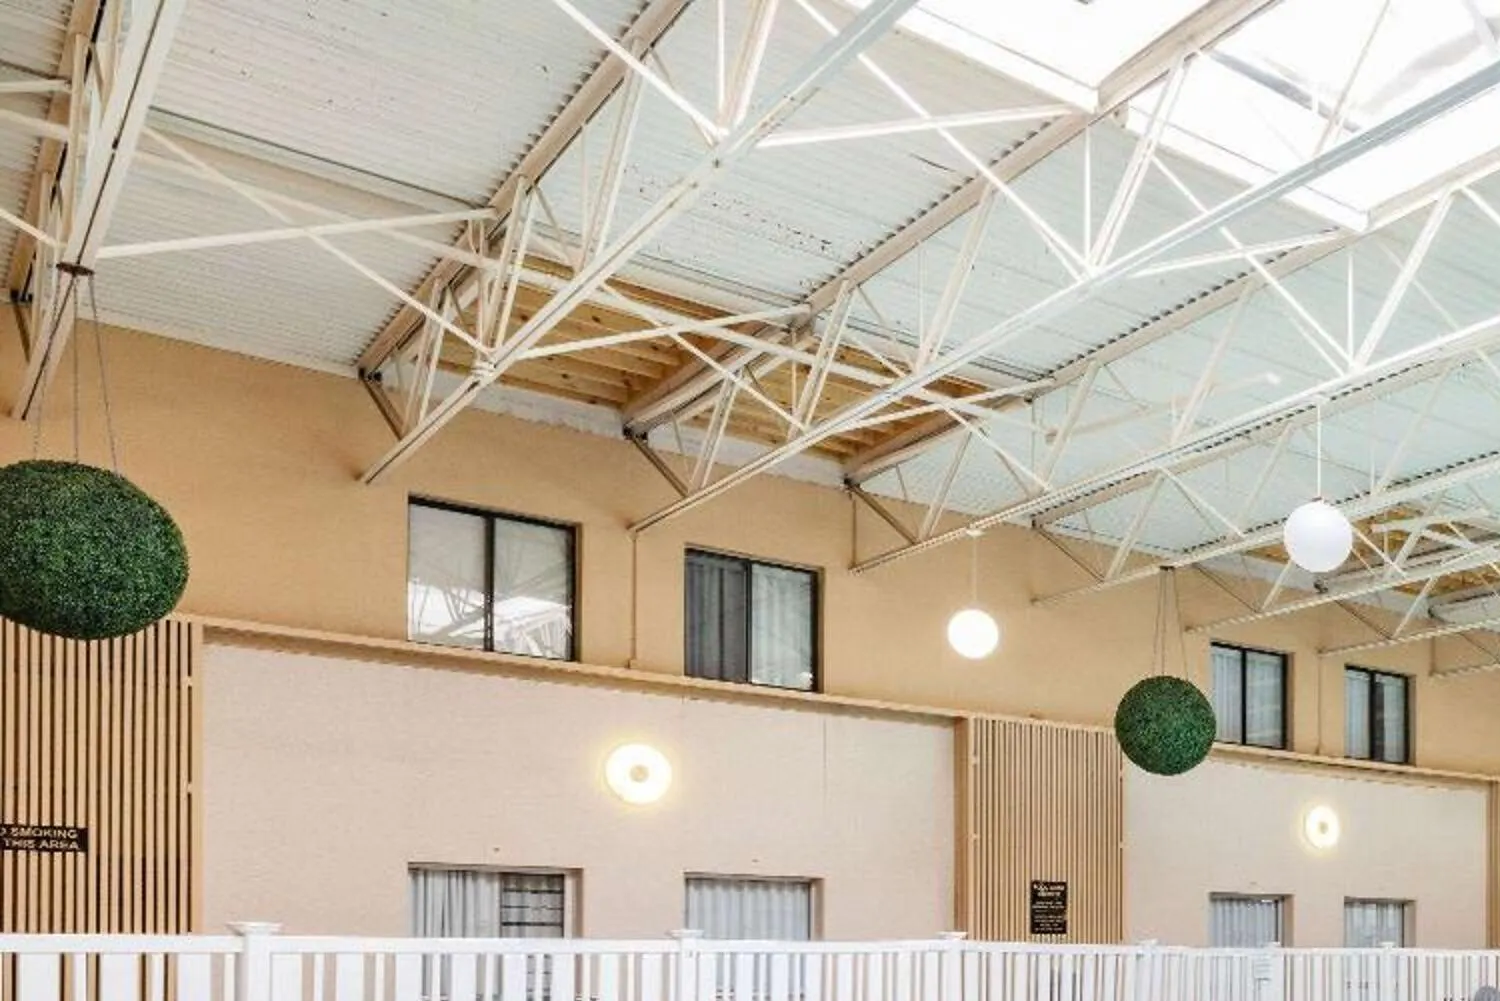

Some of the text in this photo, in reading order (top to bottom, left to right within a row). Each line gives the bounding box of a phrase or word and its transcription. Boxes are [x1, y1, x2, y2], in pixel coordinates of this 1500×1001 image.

[10, 828, 78, 839] SMOKING
[4, 837, 79, 849] THIS AREA
